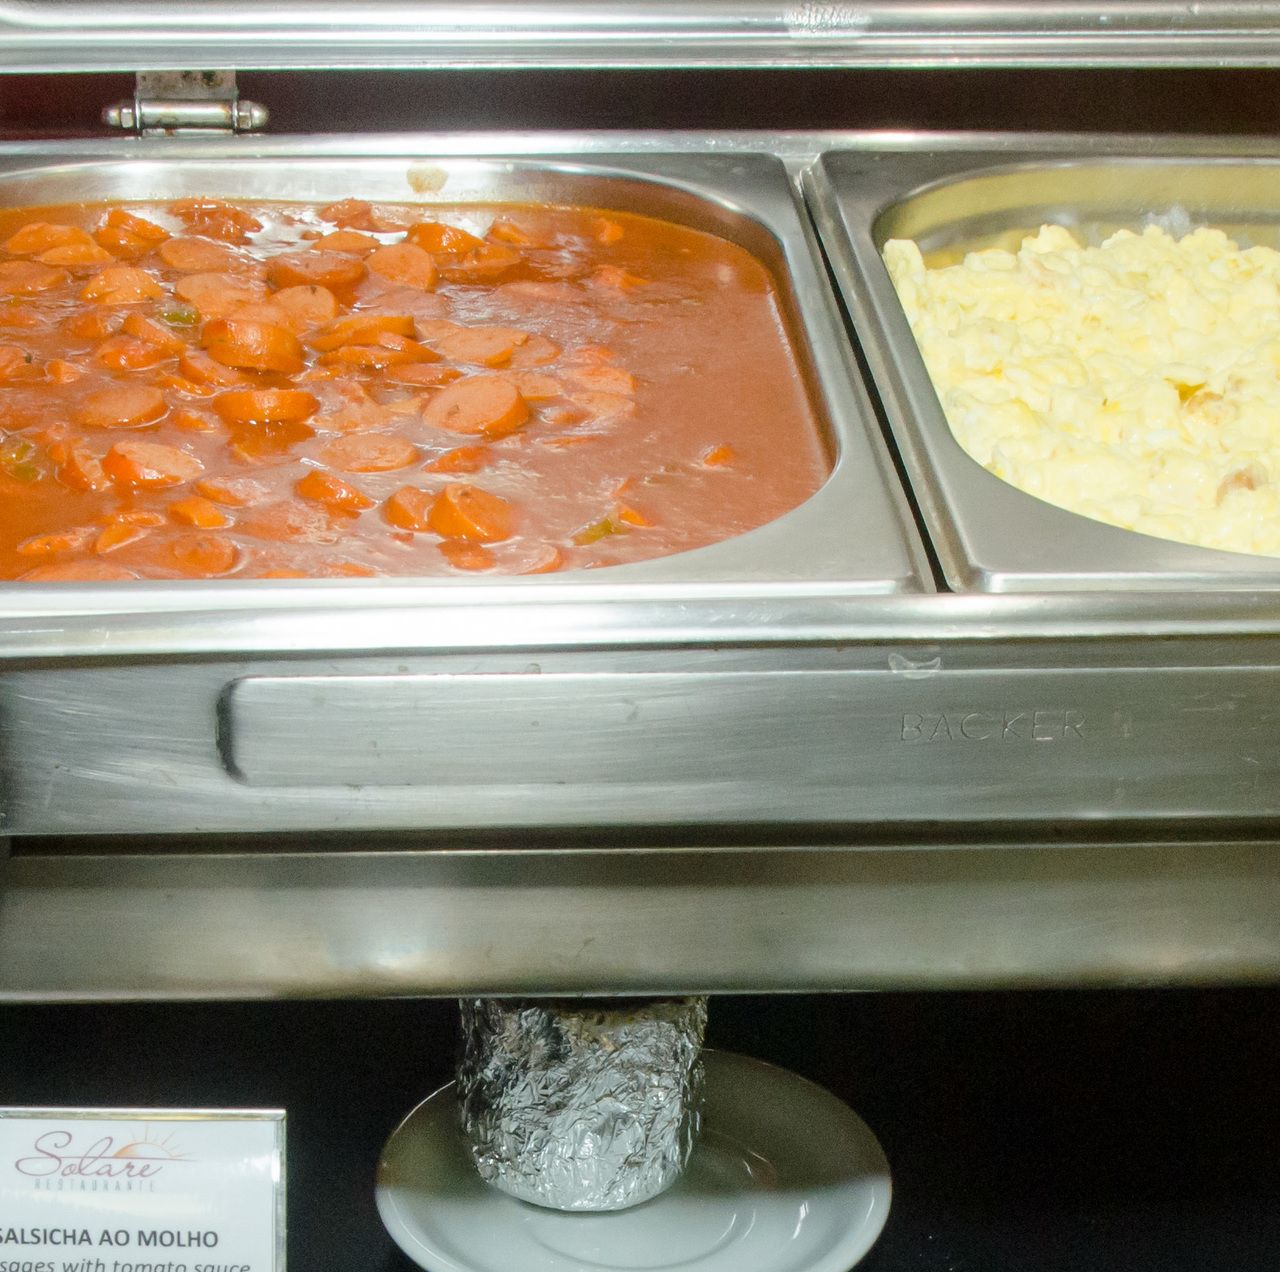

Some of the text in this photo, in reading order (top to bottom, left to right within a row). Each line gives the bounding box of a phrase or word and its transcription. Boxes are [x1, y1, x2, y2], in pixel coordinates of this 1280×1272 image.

[900, 711, 1088, 741] BACKER
[15, 1130, 163, 1178] Solare
[34, 1178, 155, 1192] RESTAURANTE
[99, 1229, 130, 1247] AO
[137, 1230, 219, 1248] MOLHO
